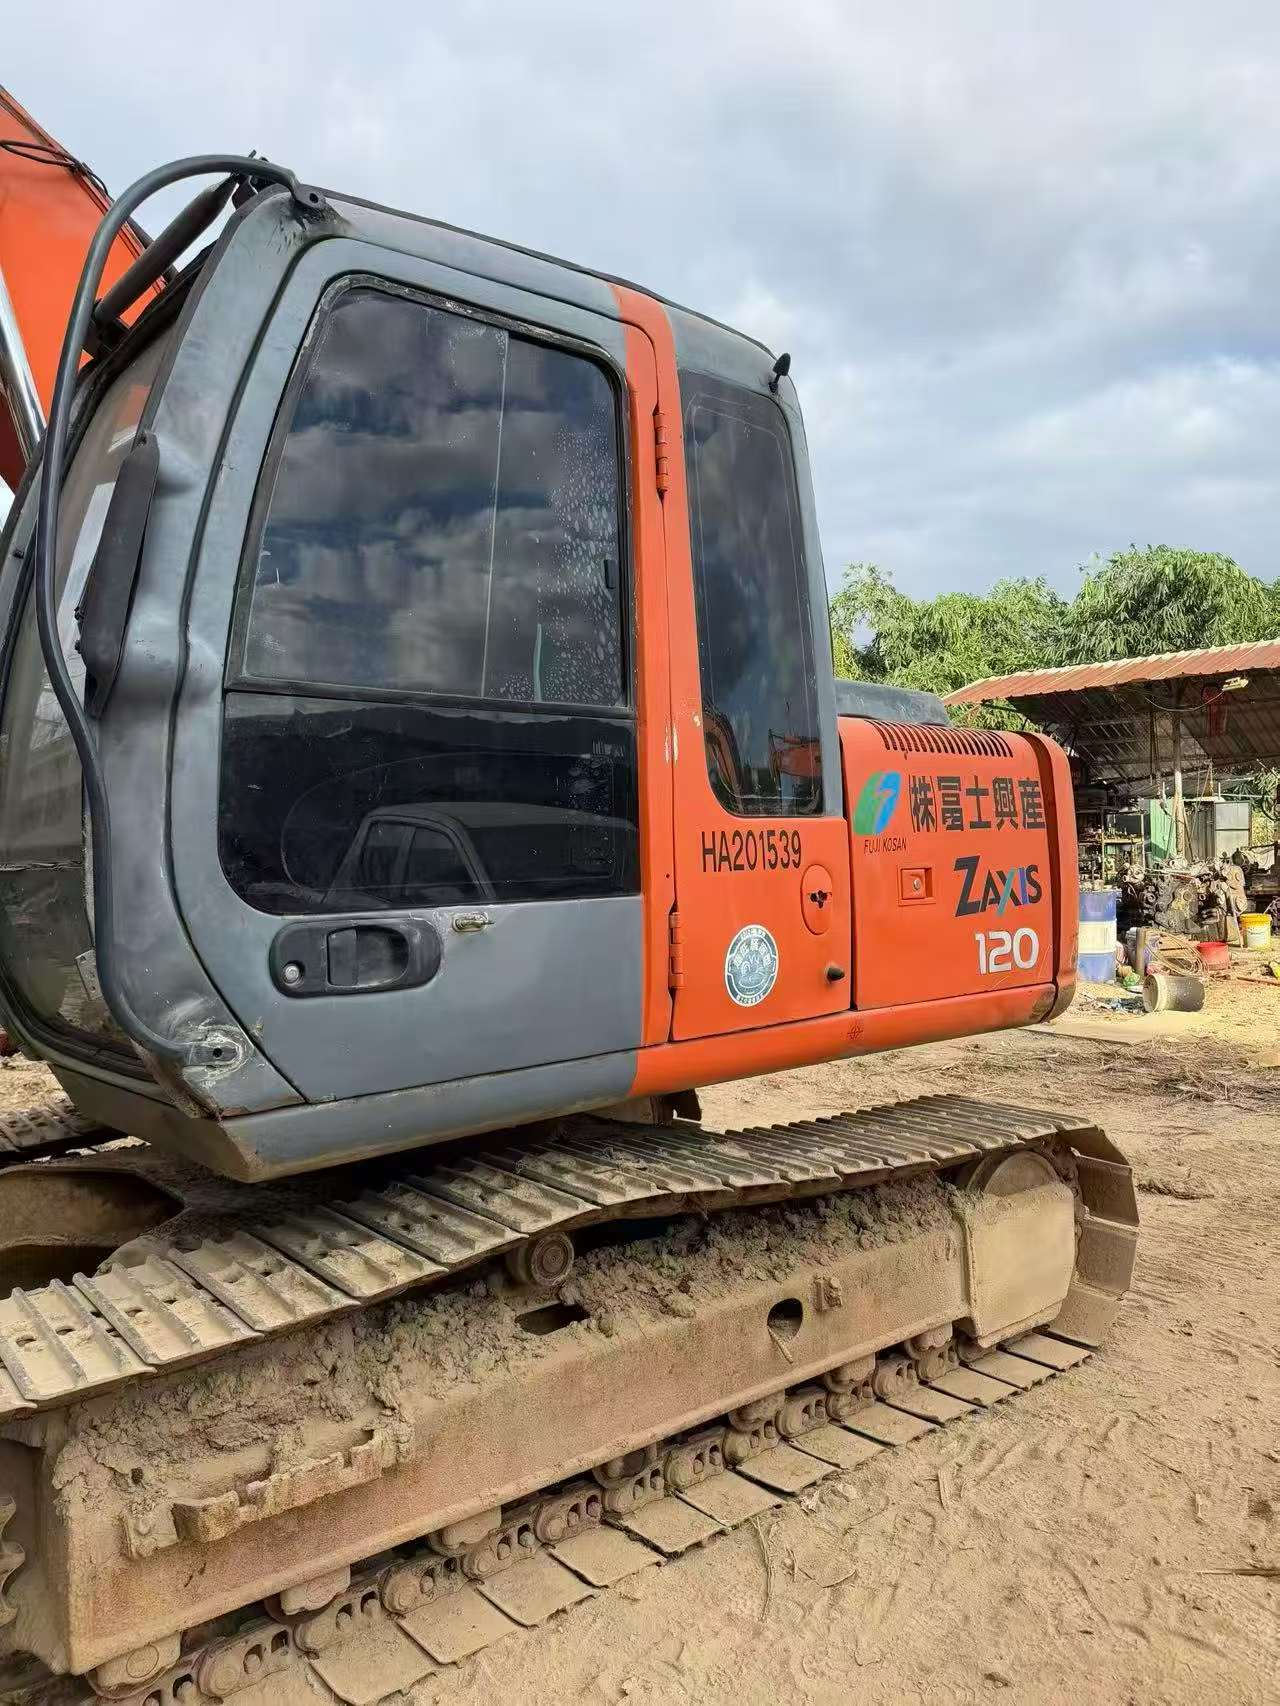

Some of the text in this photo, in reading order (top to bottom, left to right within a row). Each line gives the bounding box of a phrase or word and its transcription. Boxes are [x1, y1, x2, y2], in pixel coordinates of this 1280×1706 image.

[701, 829, 801, 873] HA201539
[863, 837, 907, 854] FUJI KOSAN
[953, 855, 1043, 917] ZAXIS
[975, 927, 1039, 975] 120
